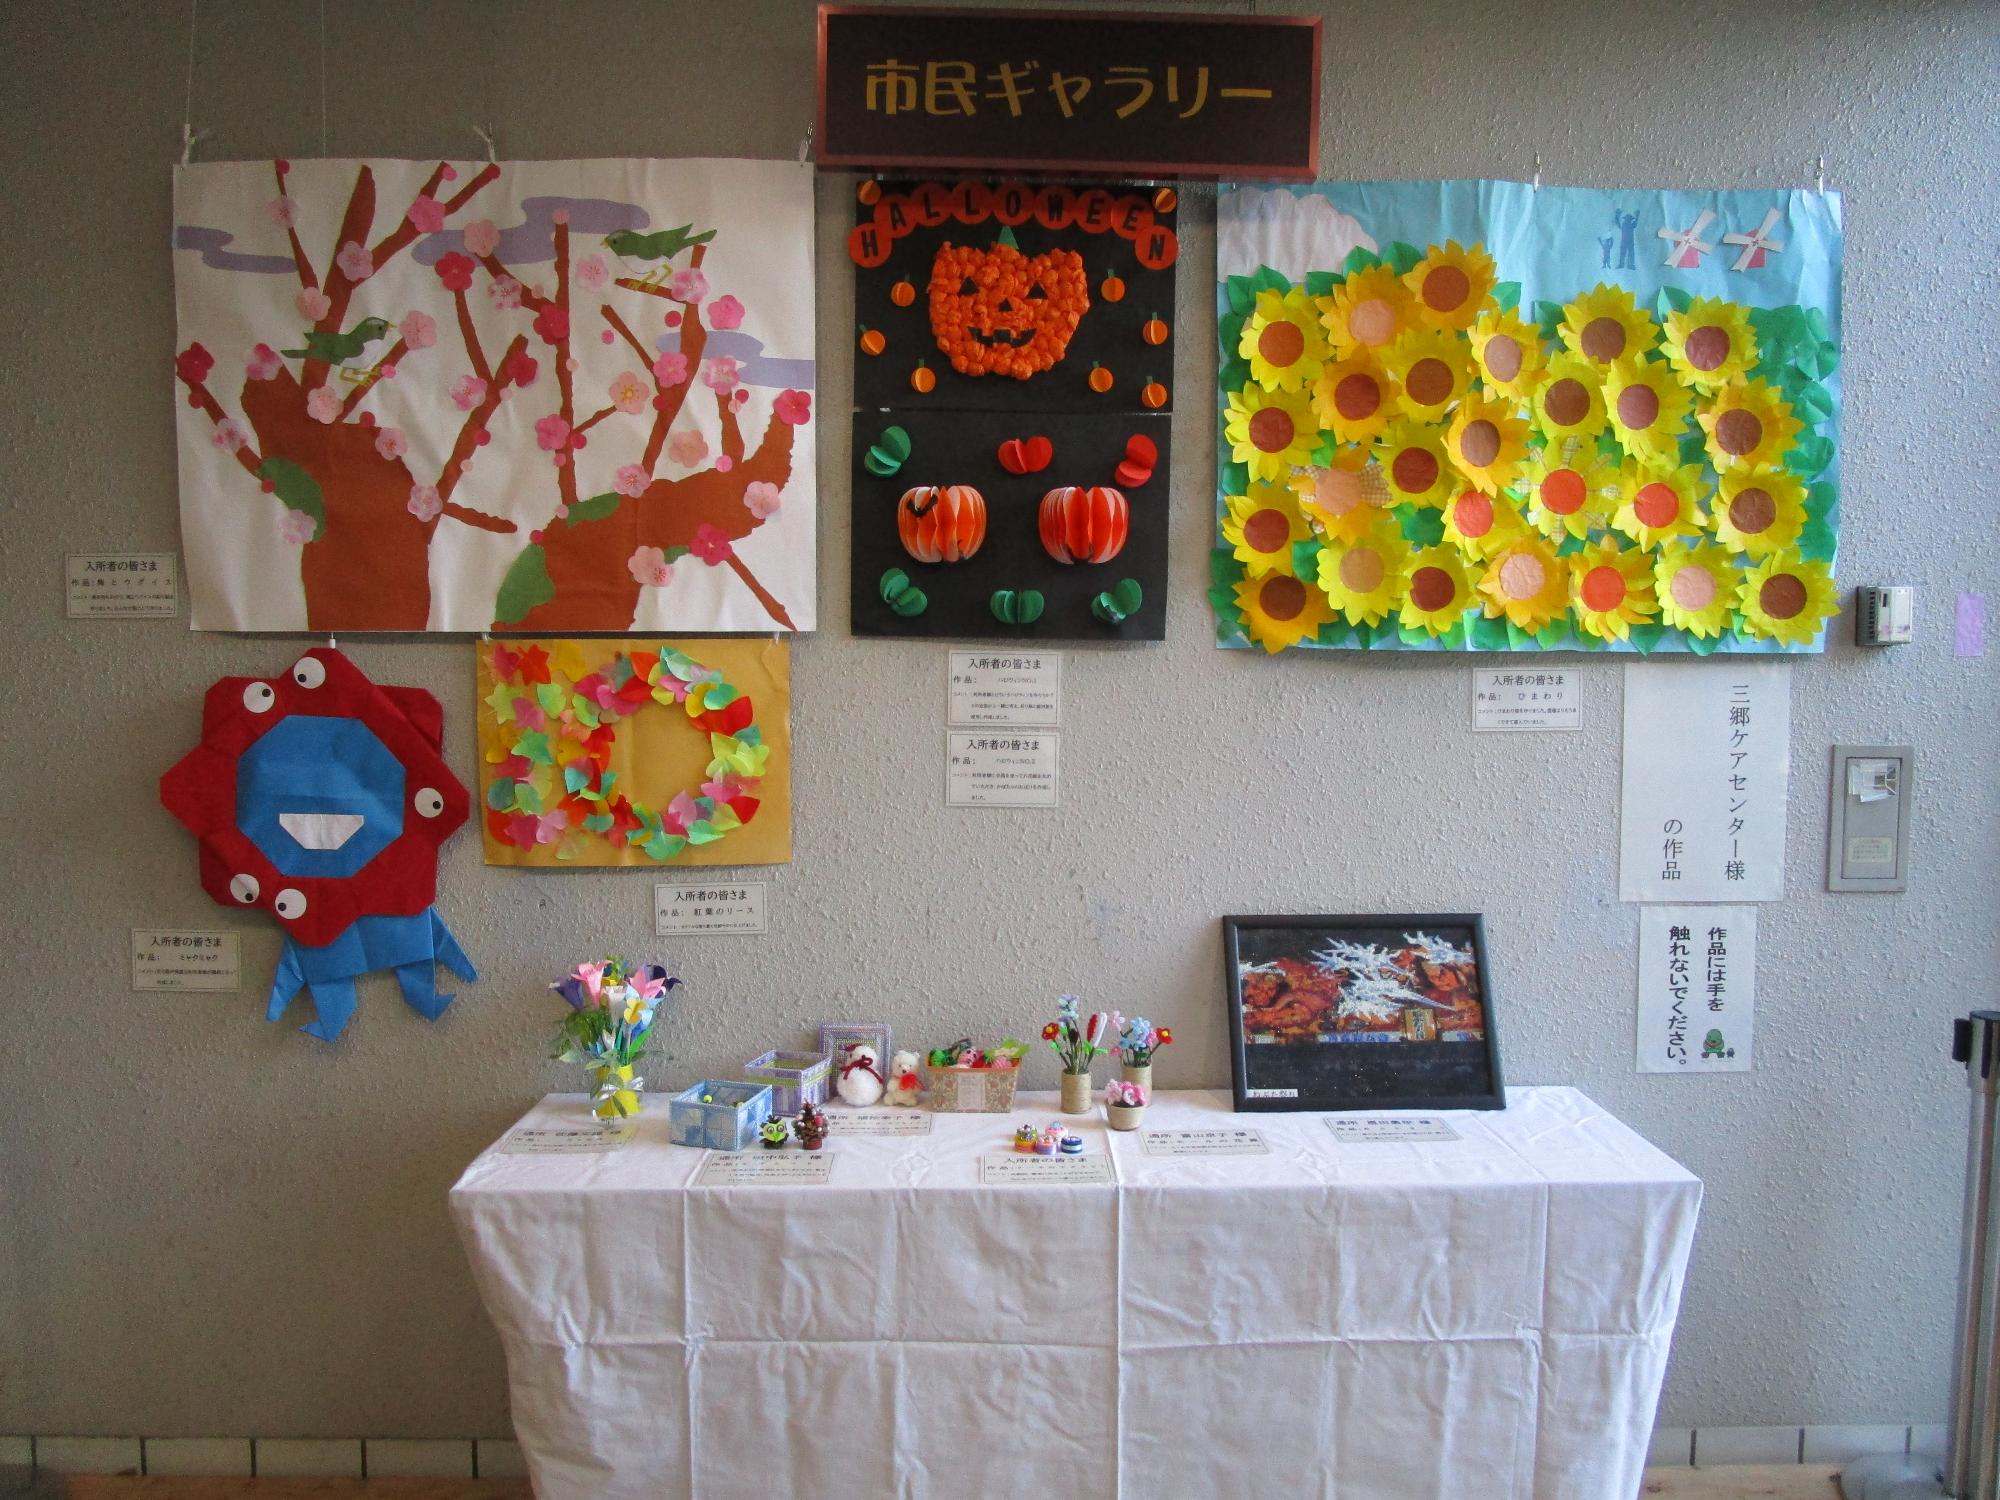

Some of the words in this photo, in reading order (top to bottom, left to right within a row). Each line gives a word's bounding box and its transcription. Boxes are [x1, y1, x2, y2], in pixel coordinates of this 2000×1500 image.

[866, 59, 1273, 119] 市民ギャラリー
[861, 191, 1166, 262] HALLOWEEN
[85, 560, 158, 572] 入所者の皆さま
[968, 658, 1041, 670] 入所者の皆さま
[1492, 674, 1564, 686] 入所者の皆さま
[1517, 692, 1564, 701] ひまわり
[967, 739, 1040, 751] 入所者の皆さま
[1724, 685, 1750, 881] 三郷ケアセンター様
[1662, 819, 1684, 880] の作品
[674, 889, 748, 902] 入所者の皆さま
[694, 907, 754, 917] 紅葉のリース
[151, 935, 223, 948] 入所者の皆さま
[1706, 927, 1728, 1012] 作品には手を
[1667, 925, 1691, 1065] 触れないでください。
